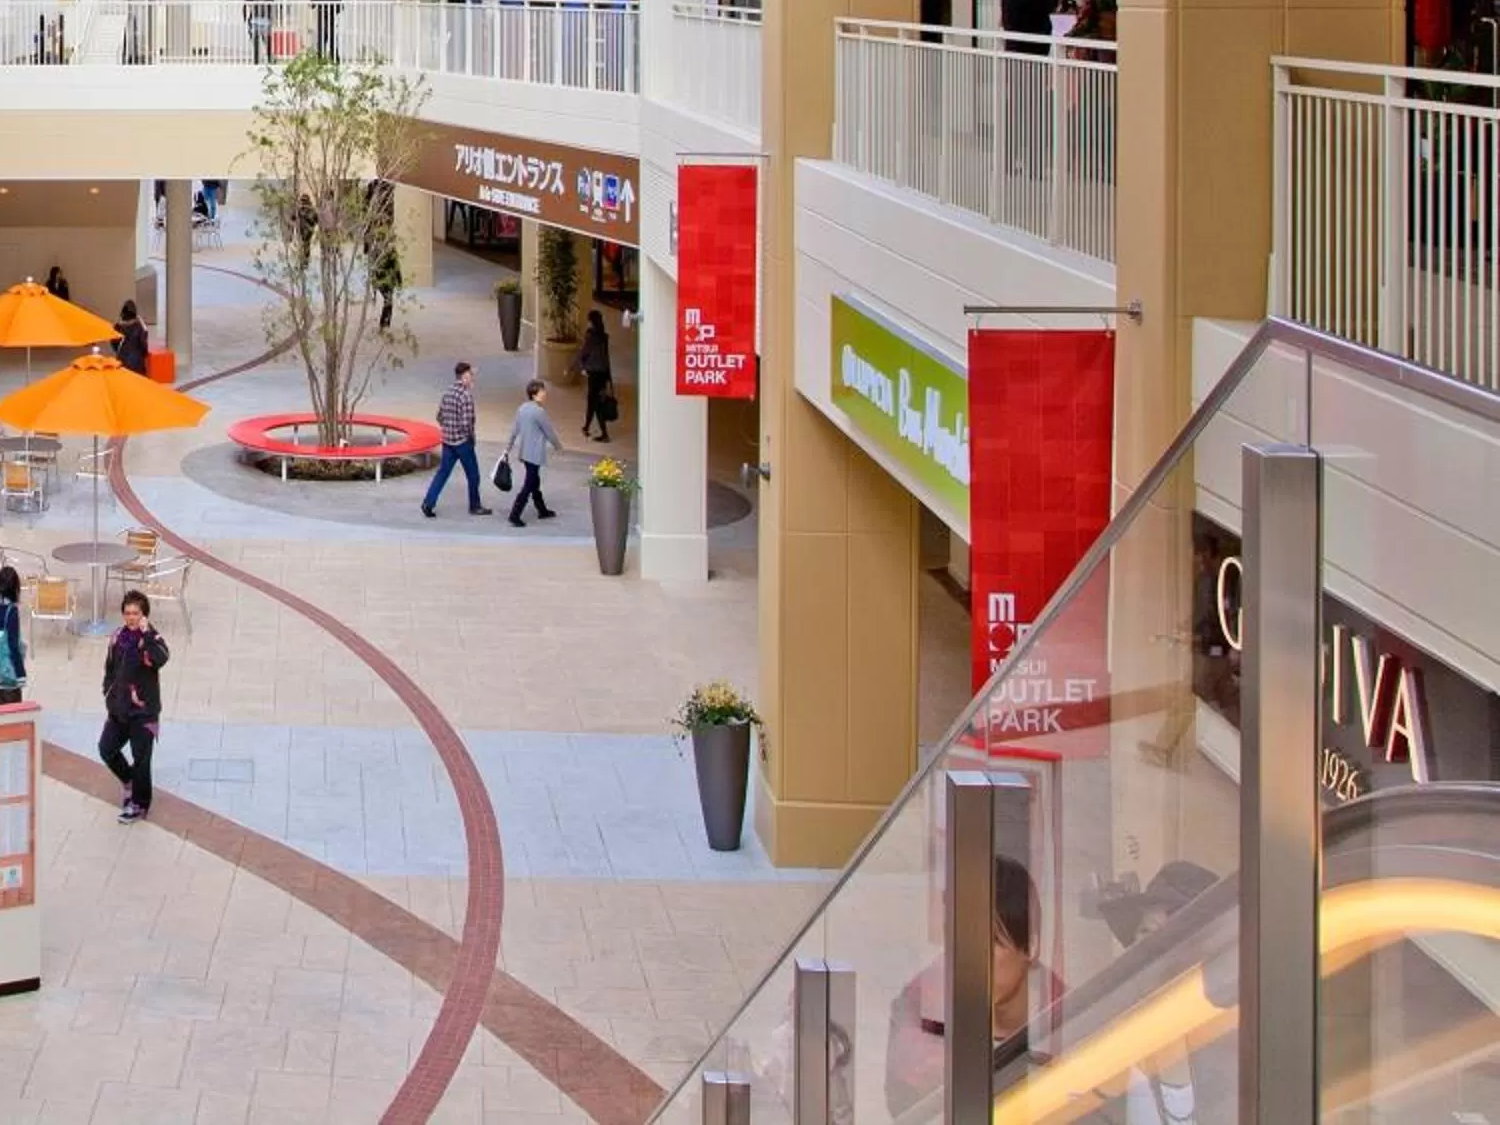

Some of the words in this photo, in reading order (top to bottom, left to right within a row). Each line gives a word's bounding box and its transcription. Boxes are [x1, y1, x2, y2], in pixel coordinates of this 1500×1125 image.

[685, 354, 746, 370] OUTLET
[685, 370, 728, 385] PARK
[1217, 556, 1430, 785] GIVA
[989, 707, 1063, 733] PARK
[1321, 747, 1361, 801] 1926
